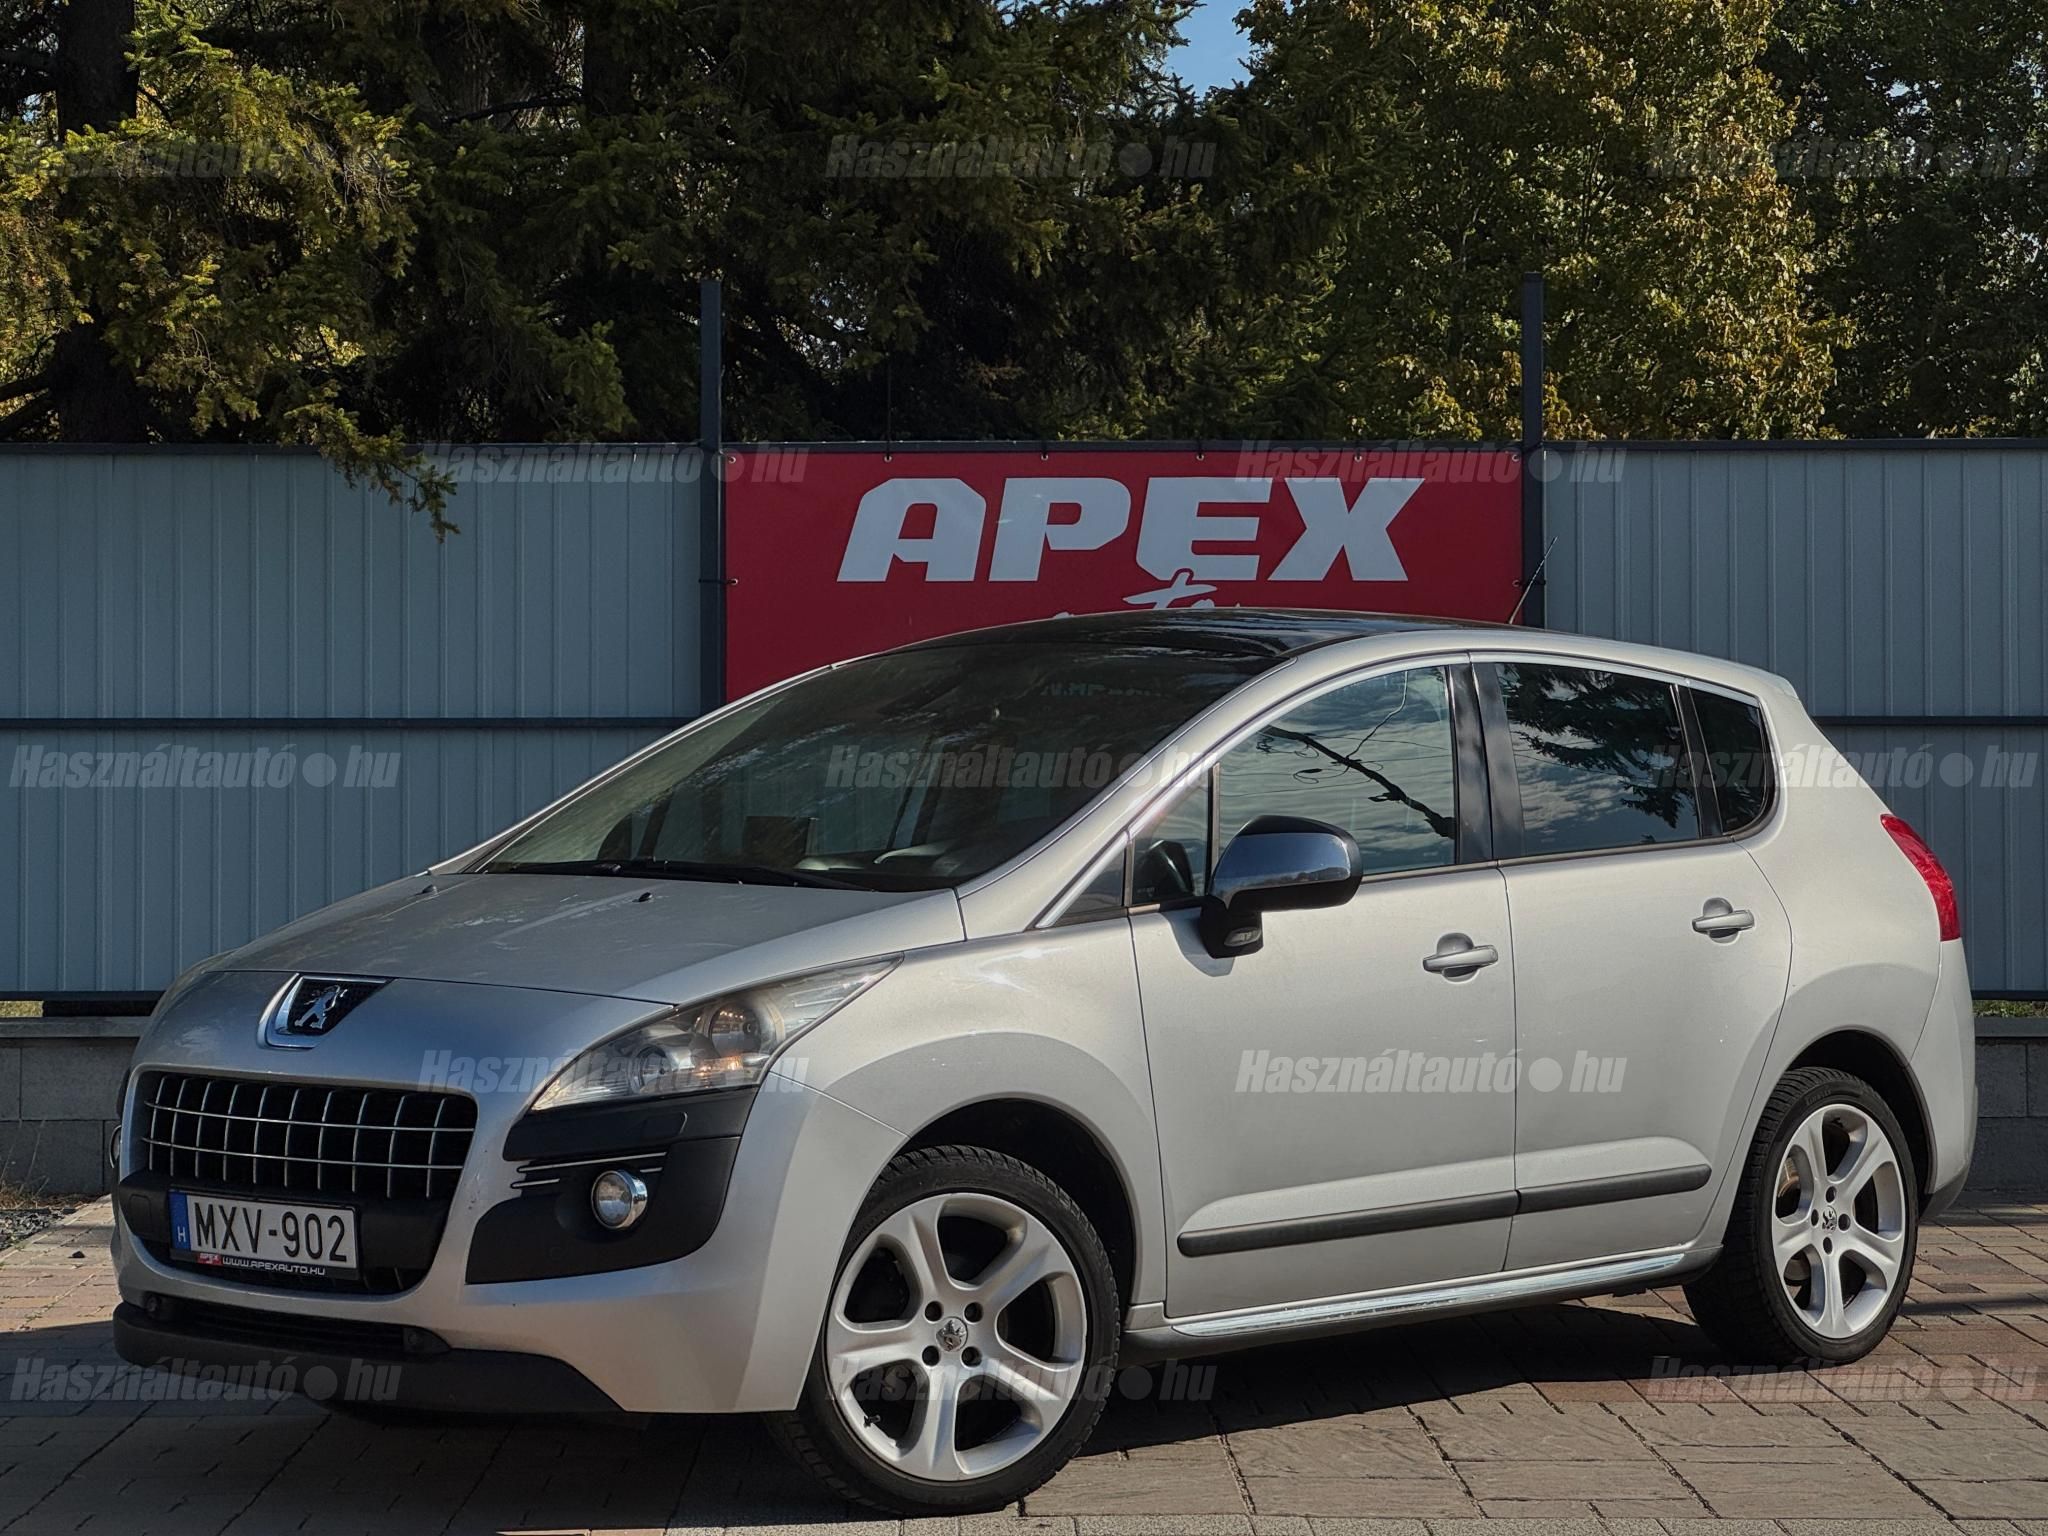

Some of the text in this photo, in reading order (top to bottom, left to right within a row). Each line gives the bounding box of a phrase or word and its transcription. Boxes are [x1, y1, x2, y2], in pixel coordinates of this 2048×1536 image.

[837, 478, 1424, 581] APEX
[177, 1226, 187, 1243] H
[194, 1202, 347, 1263] MXV-902
